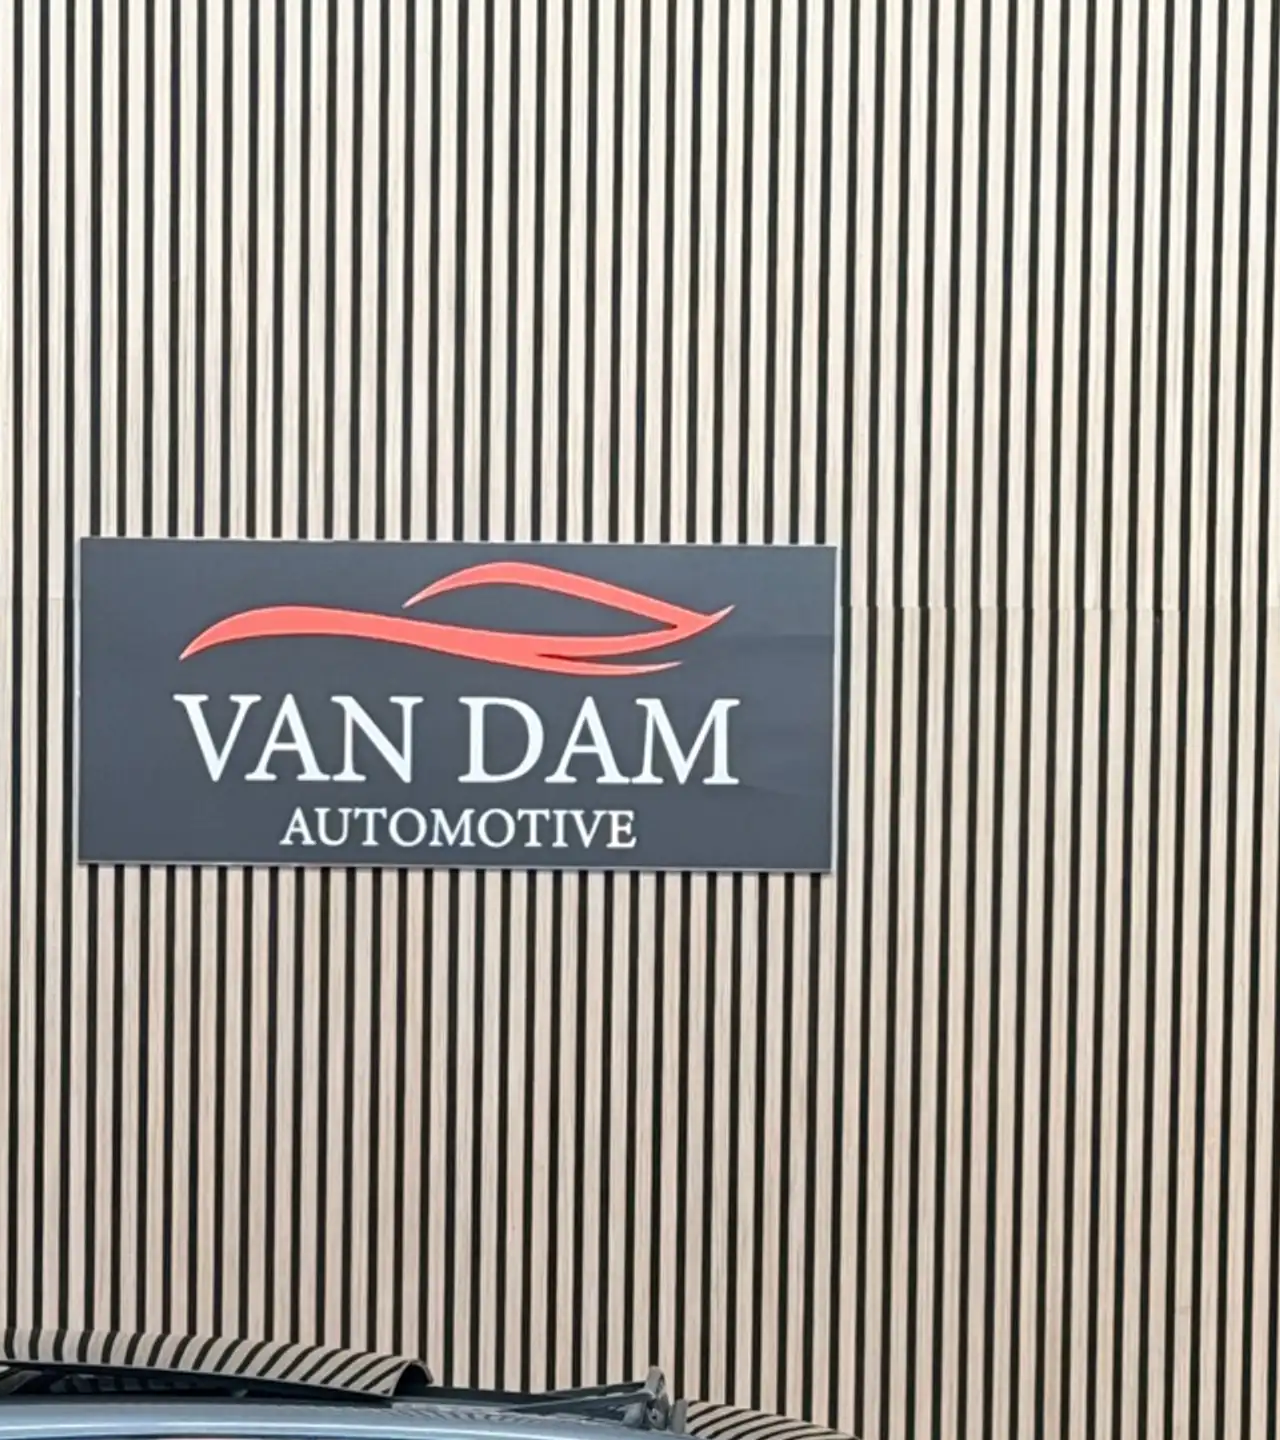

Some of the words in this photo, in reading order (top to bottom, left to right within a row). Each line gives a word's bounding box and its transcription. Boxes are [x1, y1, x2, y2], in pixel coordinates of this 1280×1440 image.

[173, 693, 424, 784] VAN
[457, 695, 741, 785] DAM
[279, 807, 637, 850] AUTOMOTIVE
